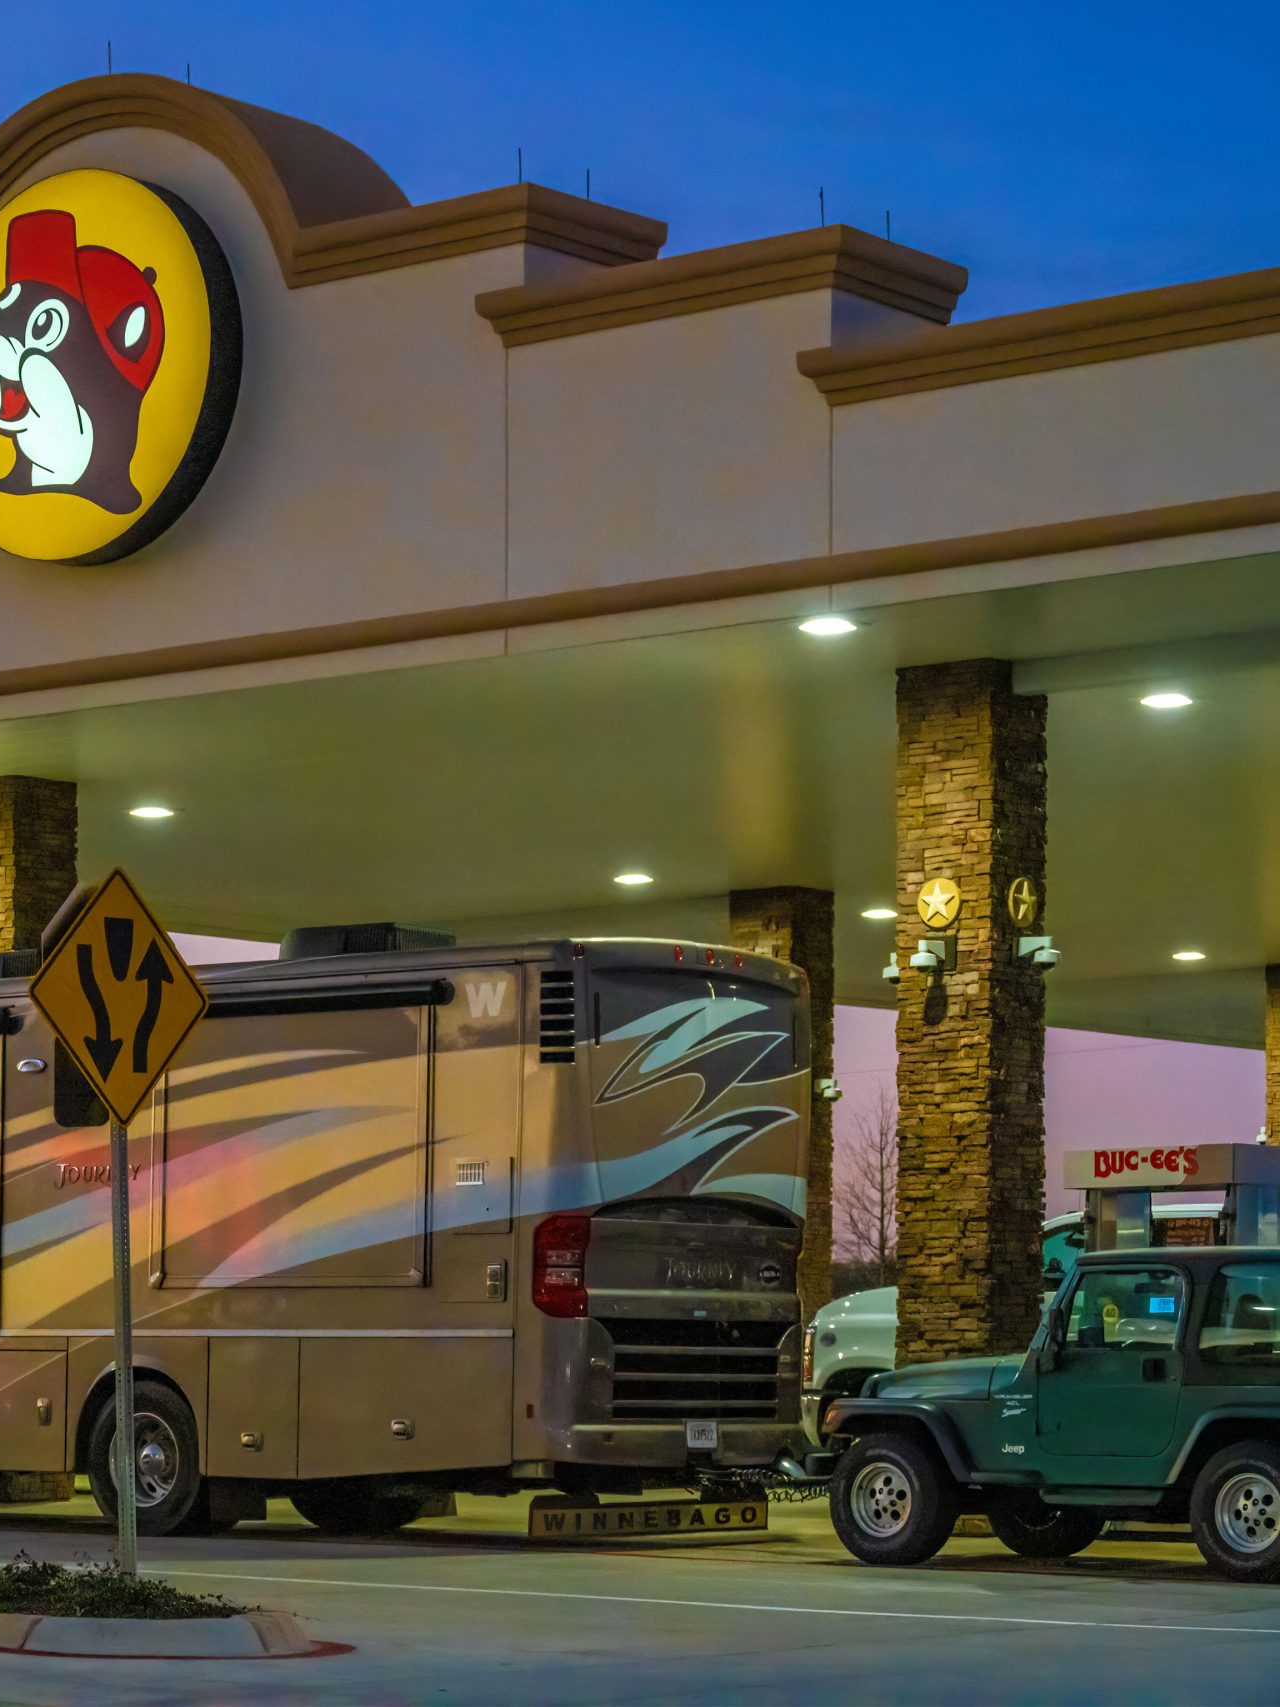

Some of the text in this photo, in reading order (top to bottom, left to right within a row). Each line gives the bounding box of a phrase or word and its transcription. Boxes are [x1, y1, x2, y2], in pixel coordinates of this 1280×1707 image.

[464, 981, 508, 1018] W
[1094, 1146, 1200, 1179] BUC-EE'S
[53, 1163, 142, 1190] JOURY
[1001, 1443, 1025, 1455] Jeep
[543, 1506, 758, 1532] WINNEBAGO
